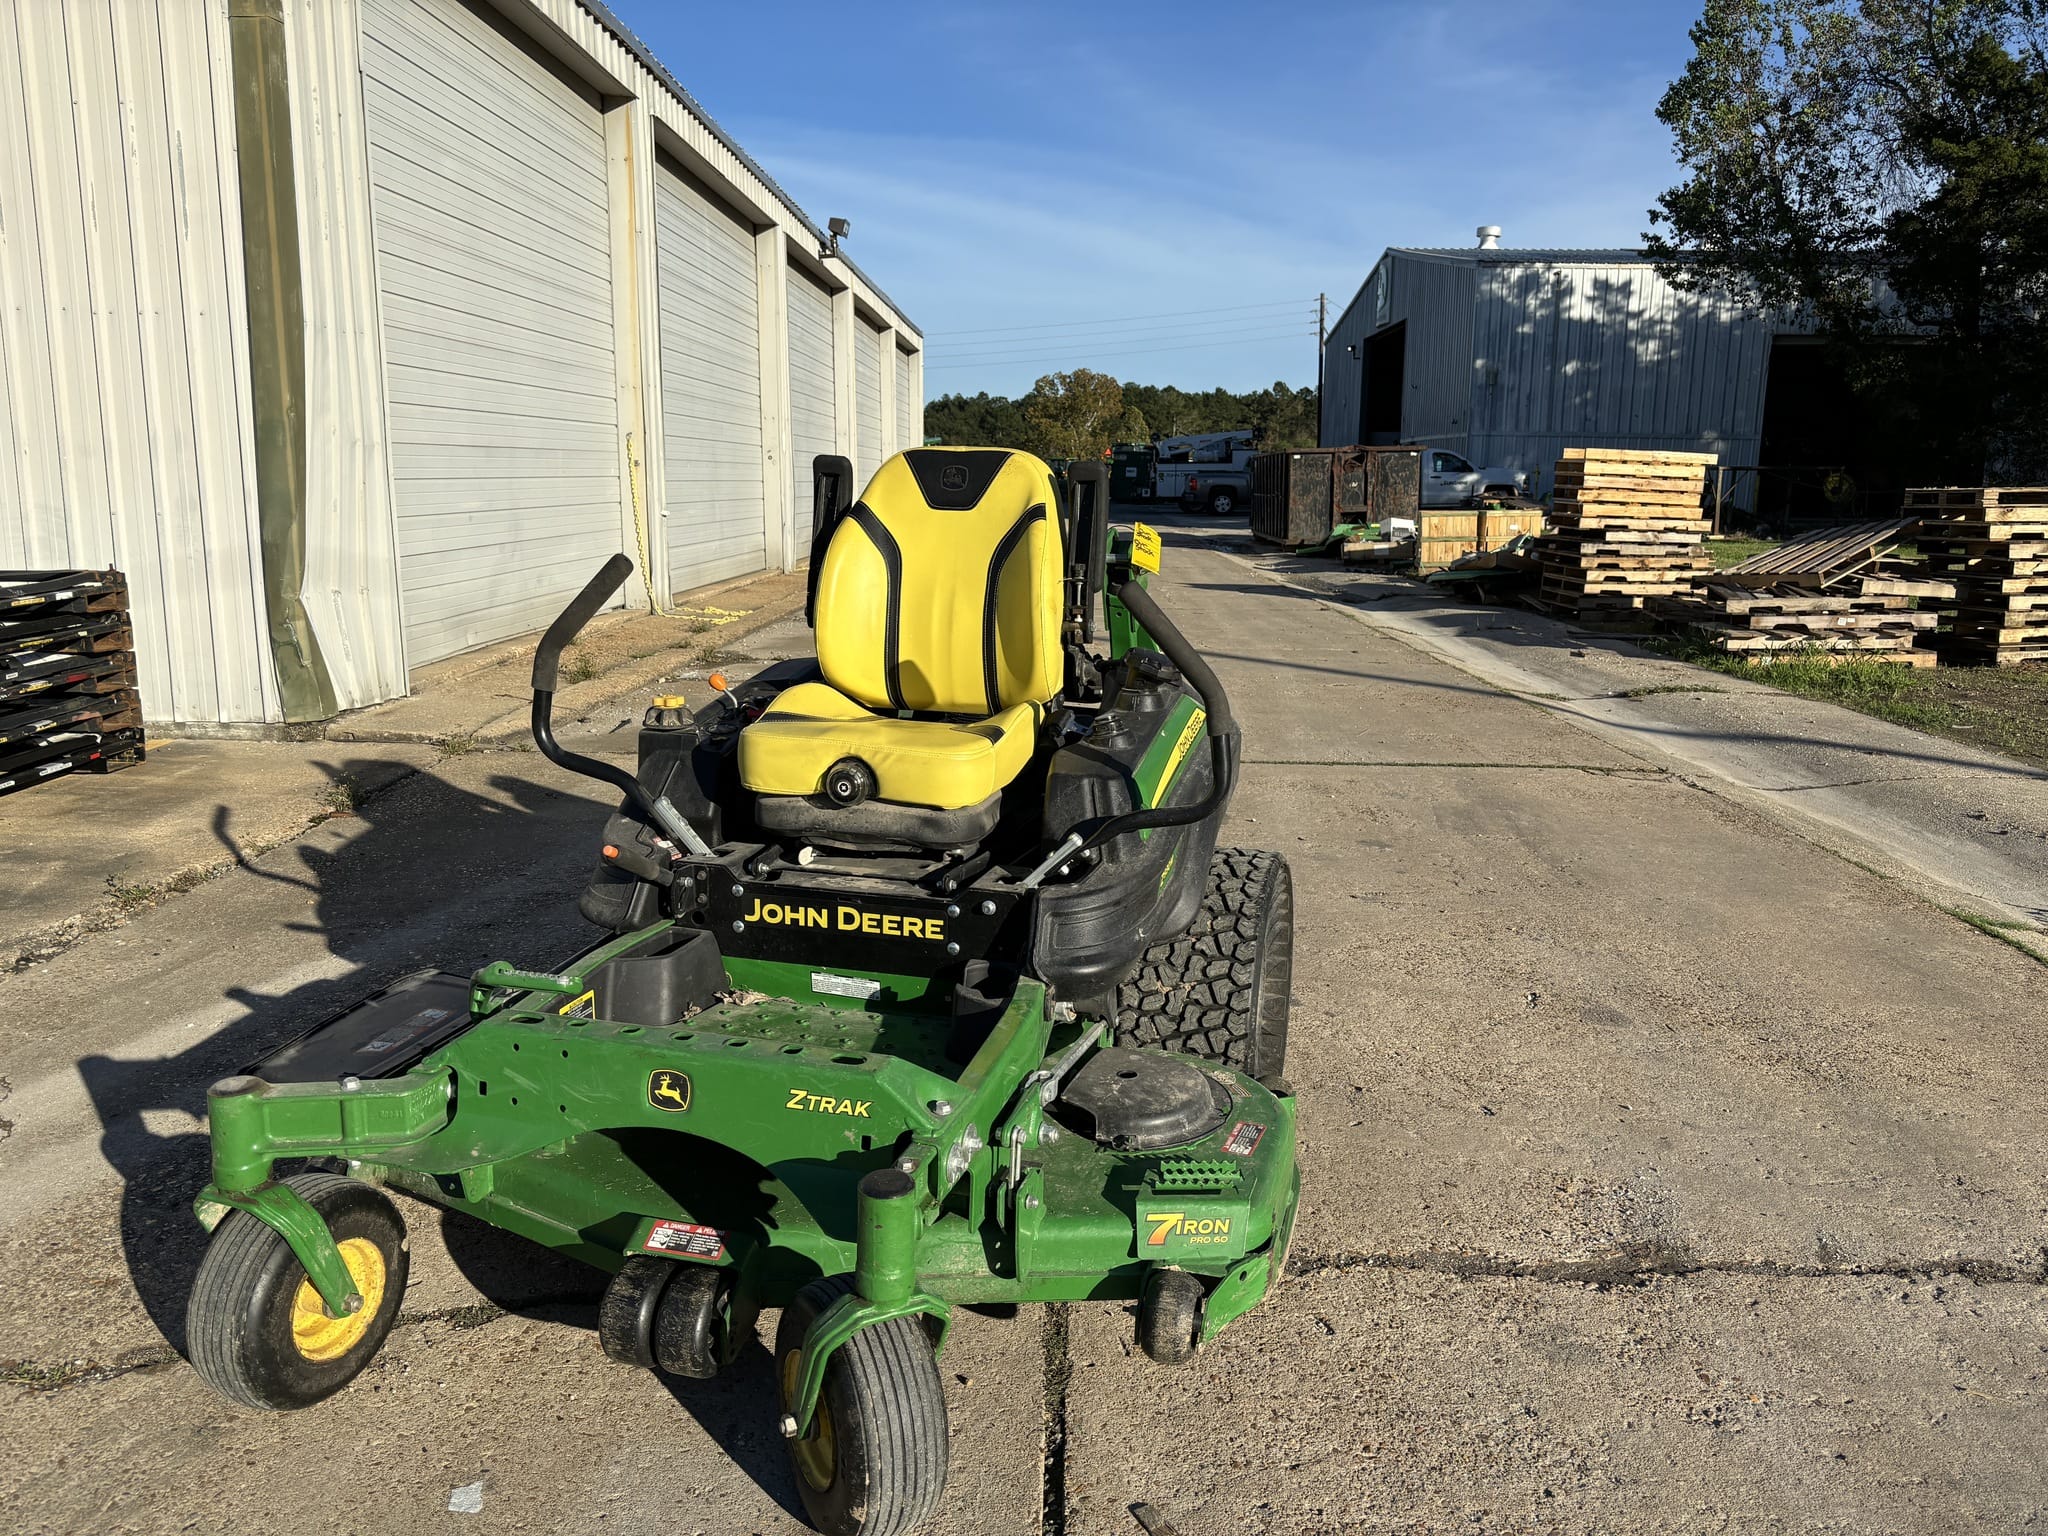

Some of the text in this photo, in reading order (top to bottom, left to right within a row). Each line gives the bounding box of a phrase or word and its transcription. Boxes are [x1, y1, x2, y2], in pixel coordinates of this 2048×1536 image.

[744, 898, 944, 940] JOHN DEERE
[785, 1088, 872, 1118] ZTRAK
[670, 1222, 691, 1231] DANGER
[1189, 1235, 1229, 1244] PRO 60
